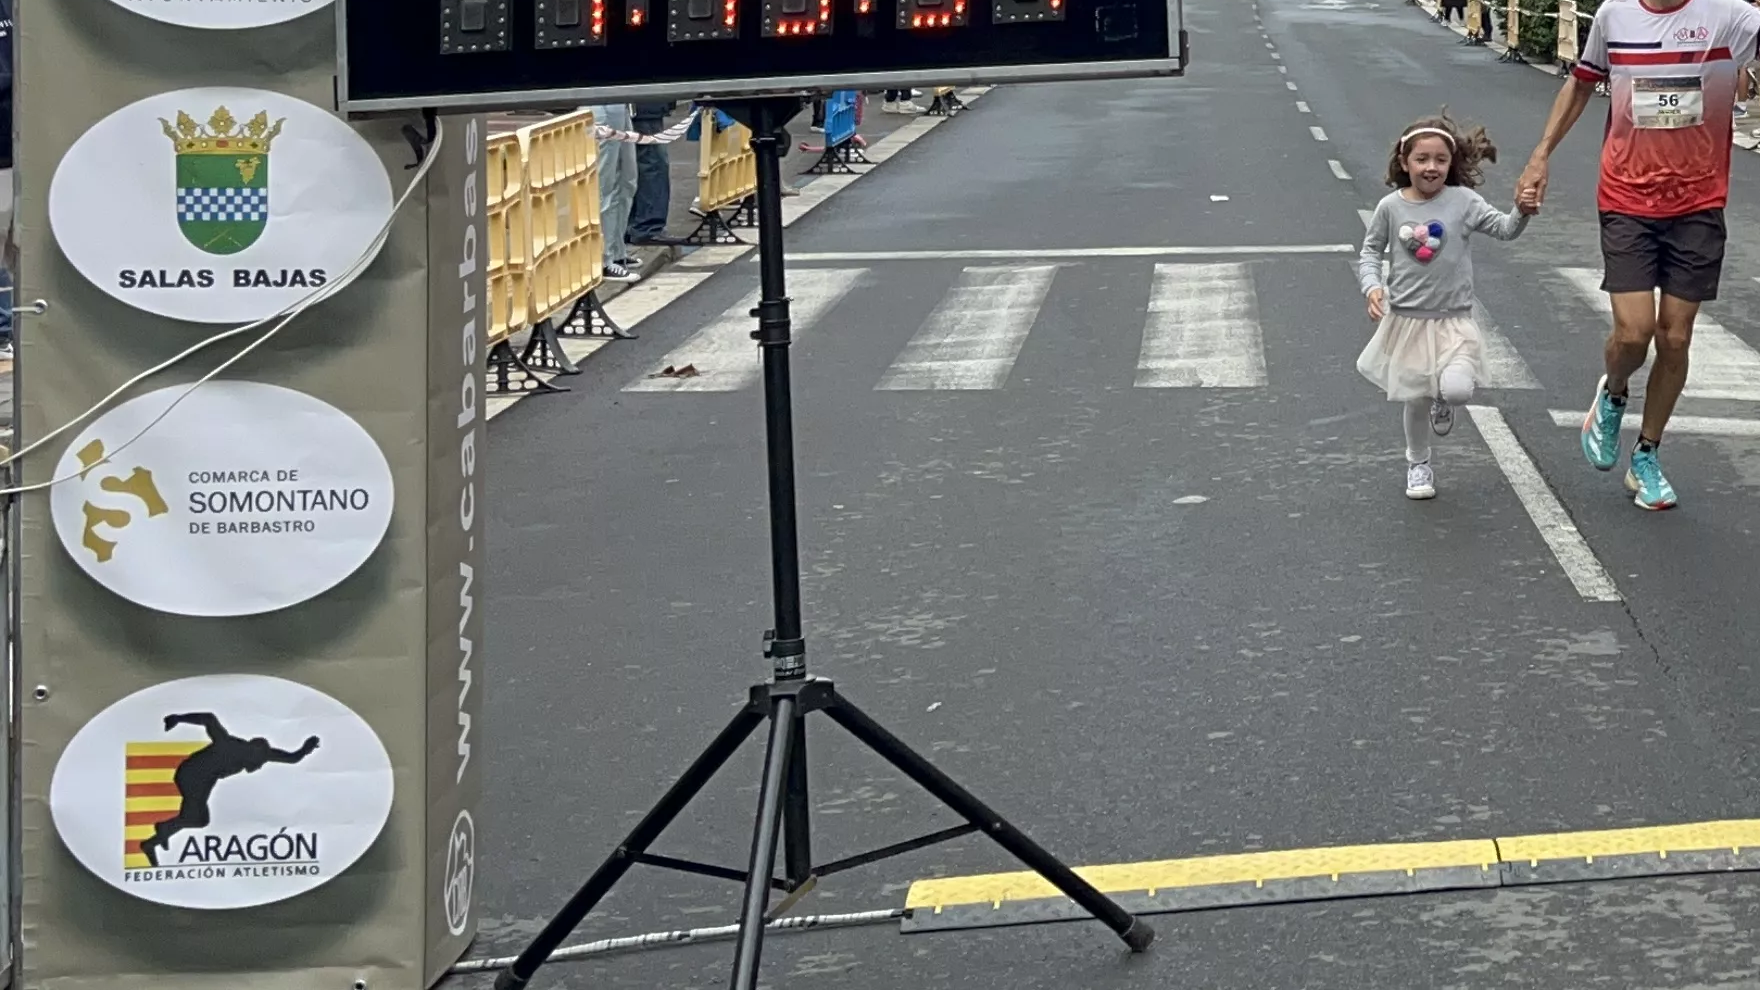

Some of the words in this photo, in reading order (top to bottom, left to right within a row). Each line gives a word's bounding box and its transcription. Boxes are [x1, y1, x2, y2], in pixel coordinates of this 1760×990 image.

[1658, 94, 1679, 107] 56
[119, 269, 214, 288] SALAS
[233, 269, 327, 288] BAJAS
[188, 470, 271, 483] COMARCA
[277, 469, 299, 482] DE
[188, 488, 369, 514] SOMONTANO
[189, 521, 212, 534] DE
[217, 520, 315, 533] BARBASTRO
[178, 826, 317, 863] ARAGÓN
[125, 866, 226, 882] FEDERACIÓN
[233, 864, 321, 878] ATLETISMO
